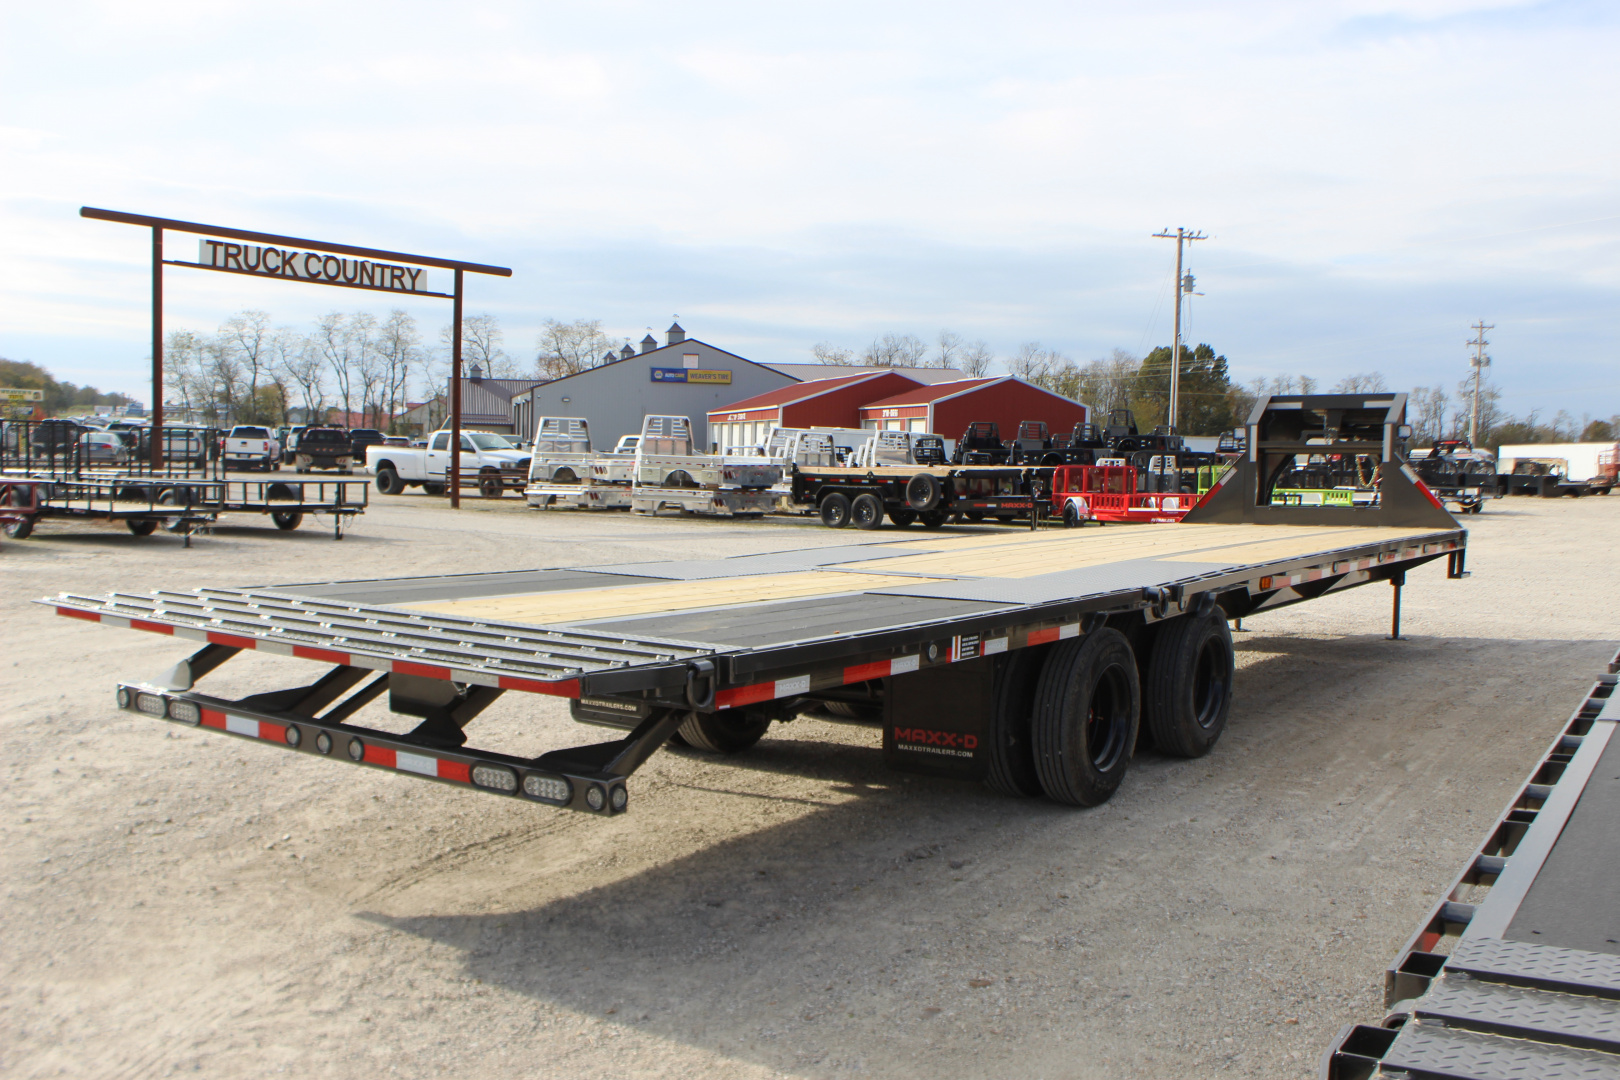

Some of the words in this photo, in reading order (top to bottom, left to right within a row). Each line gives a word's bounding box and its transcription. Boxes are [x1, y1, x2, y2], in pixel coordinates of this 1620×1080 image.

[206, 240, 299, 277] TRUCK
[304, 252, 422, 291] COUNTRY
[894, 726, 978, 749] MAXX-D
[898, 743, 973, 758] MAXXDTRAILERS.COM
